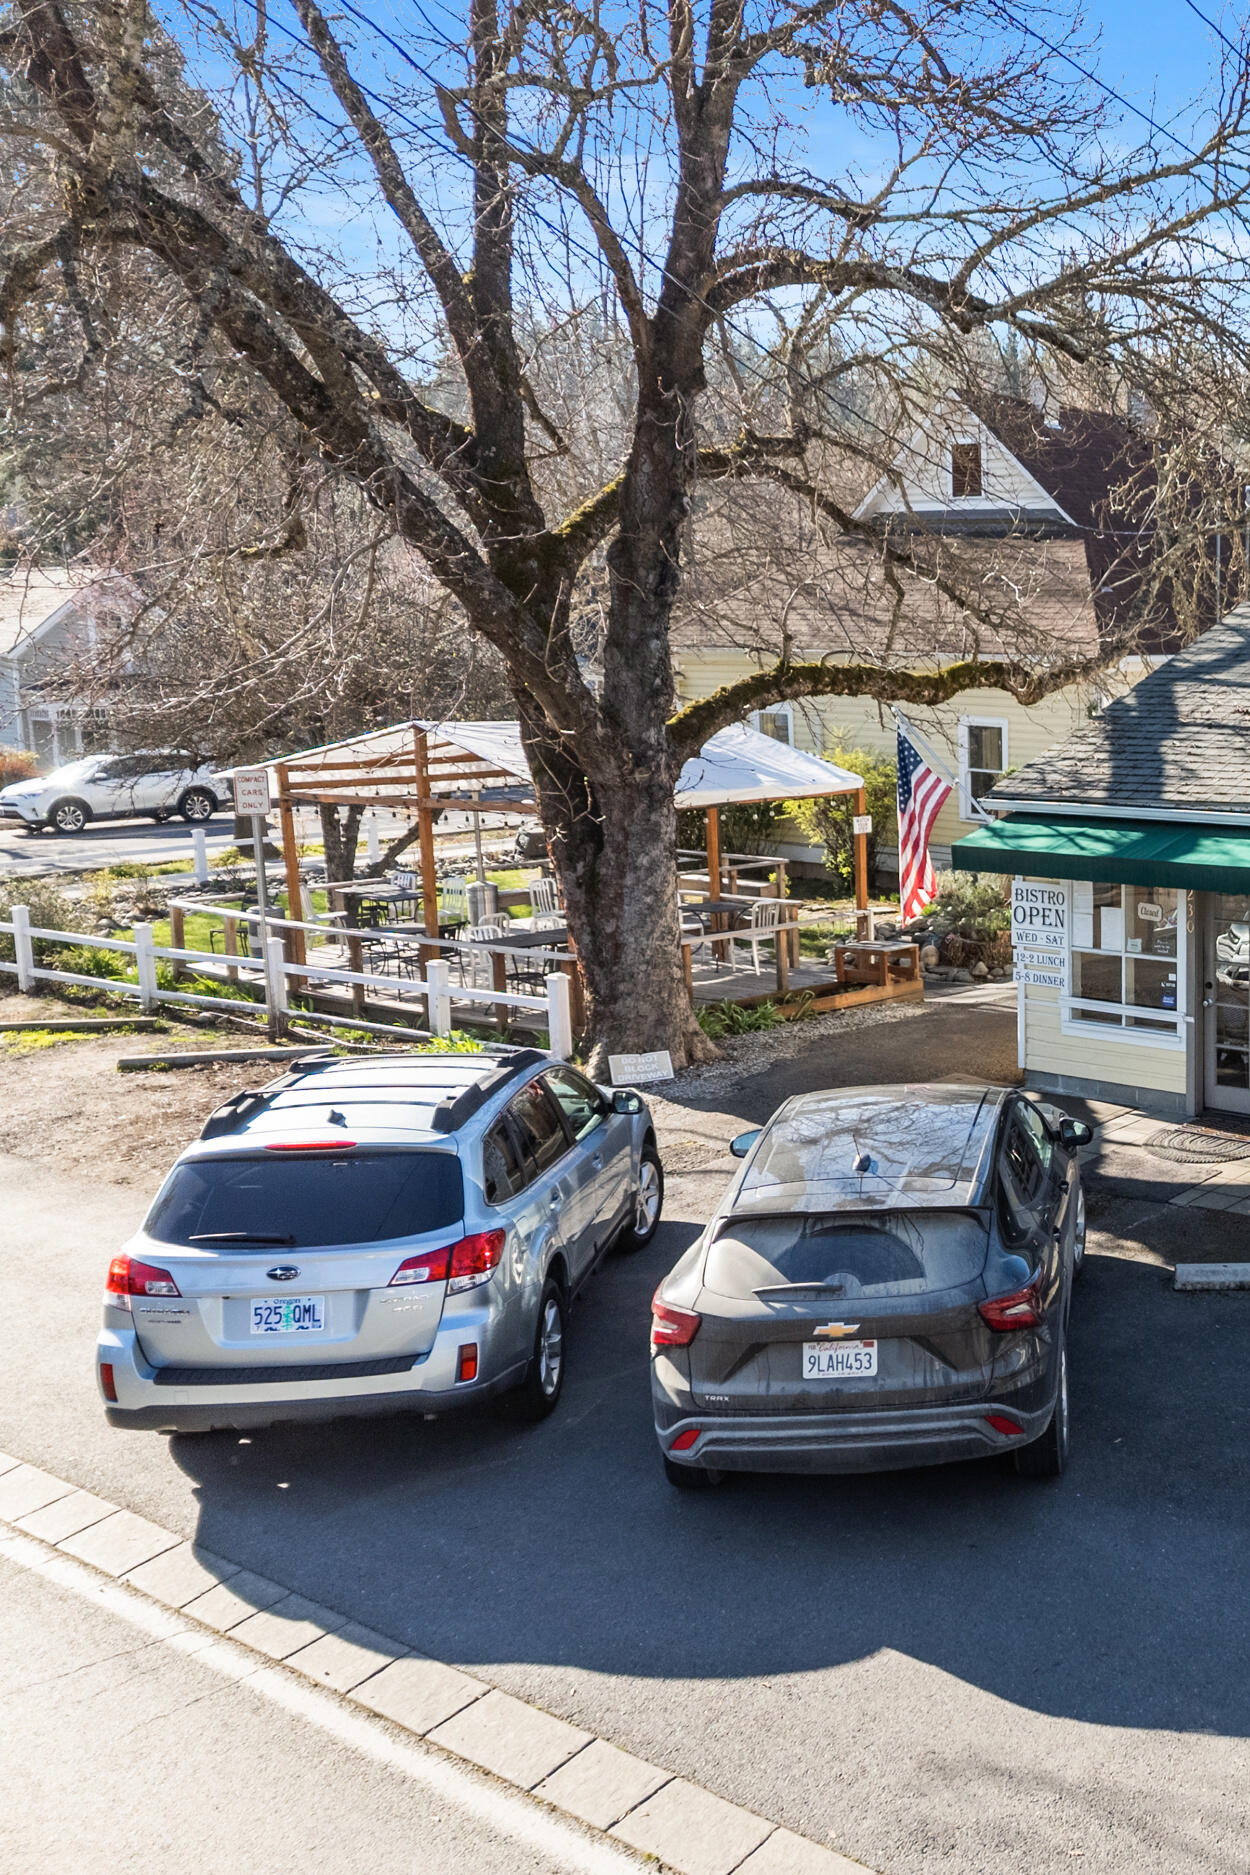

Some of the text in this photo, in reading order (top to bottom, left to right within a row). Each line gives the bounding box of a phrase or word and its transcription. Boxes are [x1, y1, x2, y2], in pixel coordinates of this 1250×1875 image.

[1014, 887, 1065, 906] BISTRO
[1013, 905, 1065, 928] OPEN
[1140, 906, 1160, 918] Closed
[1016, 931, 1038, 943] WED
[1045, 934, 1065, 946] SAT
[1016, 952, 1065, 968] 12-2 LUNCH
[1015, 971, 1065, 988] 5-8 DINNER
[620, 1054, 659, 1065] DO NOT
[617, 1070, 669, 1081] DRIVEWAY
[624, 1063, 659, 1073] BLOCK
[273, 1298, 301, 1306] Oregon
[253, 1303, 321, 1326] 525 QML
[818, 1342, 860, 1354] California
[808, 1352, 872, 1374] 9LAH453
